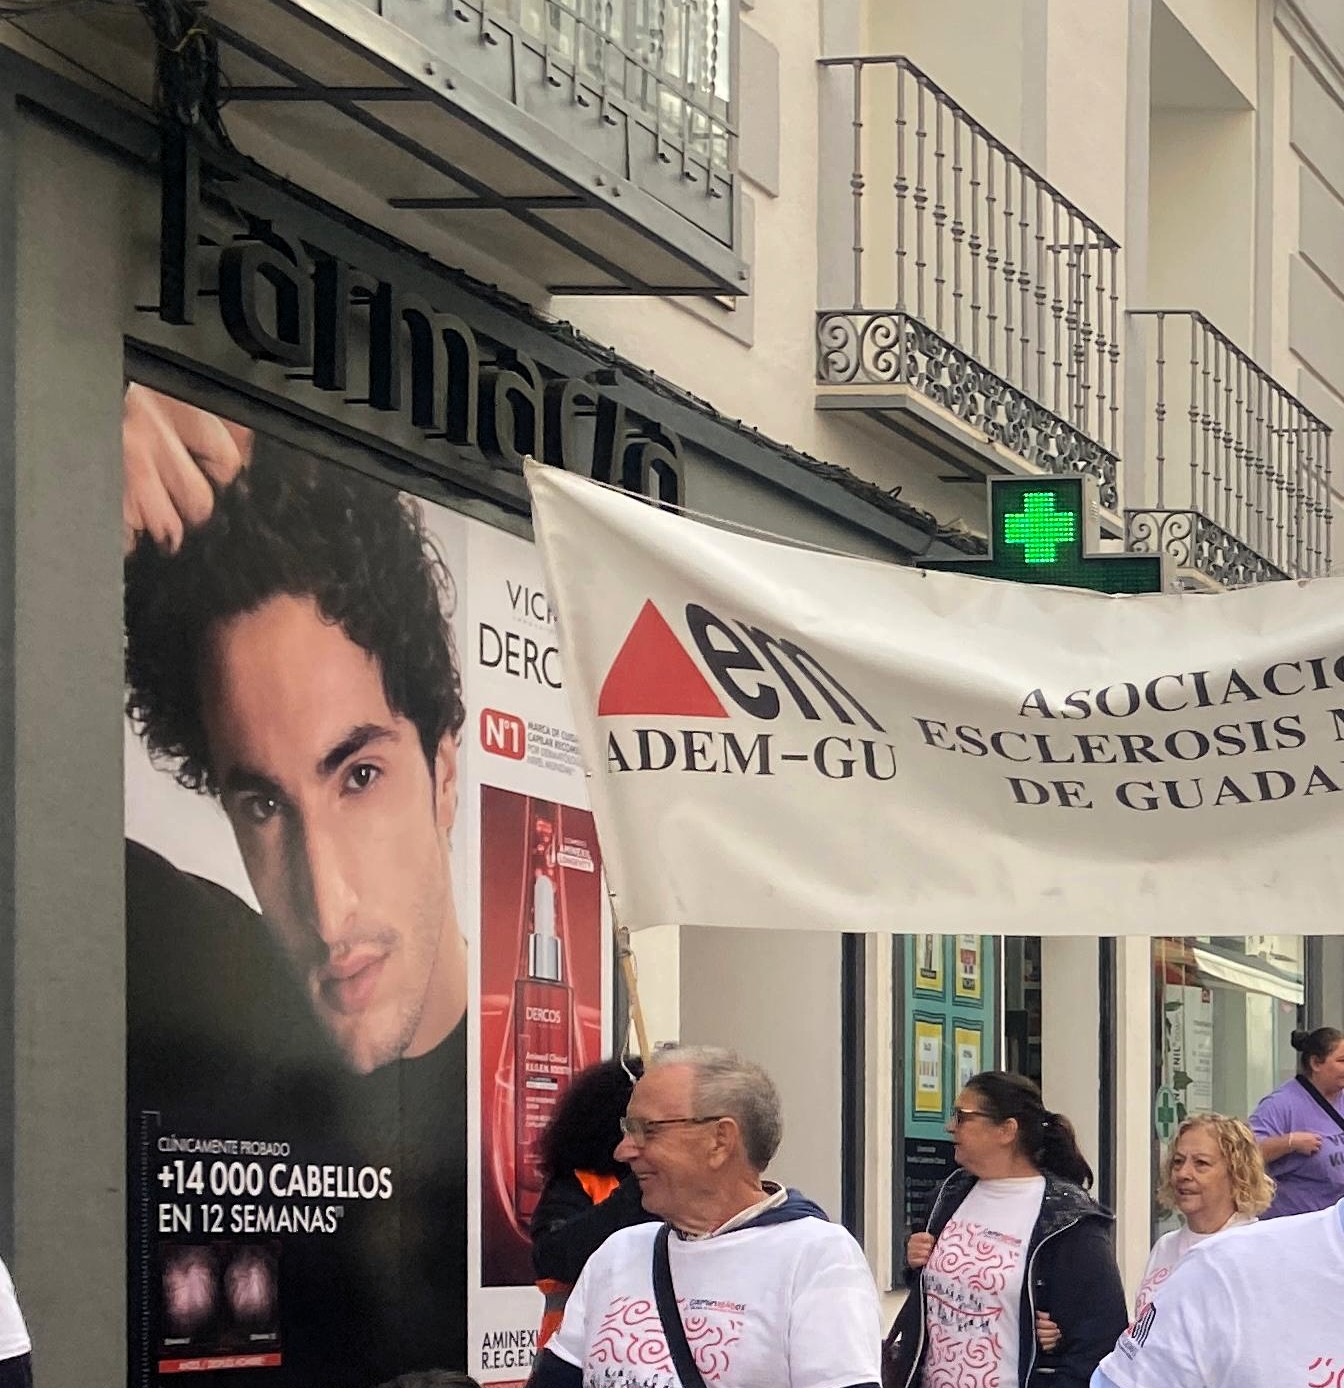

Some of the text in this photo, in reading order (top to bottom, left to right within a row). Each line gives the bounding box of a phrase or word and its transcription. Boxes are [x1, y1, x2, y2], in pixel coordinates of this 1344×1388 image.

[479, 622, 562, 689] DERC
[607, 728, 898, 781] ADEM-GU
[912, 715, 1308, 765] ESCLEROSIS
[1005, 776, 1095, 809] DE
[525, 1007, 561, 1024] DERCOS
[240, 1140, 291, 1157] PROBADO
[157, 1160, 394, 1200] +14 000 CABELLOS
[157, 1203, 338, 1234] EN 12 SEMANAS
